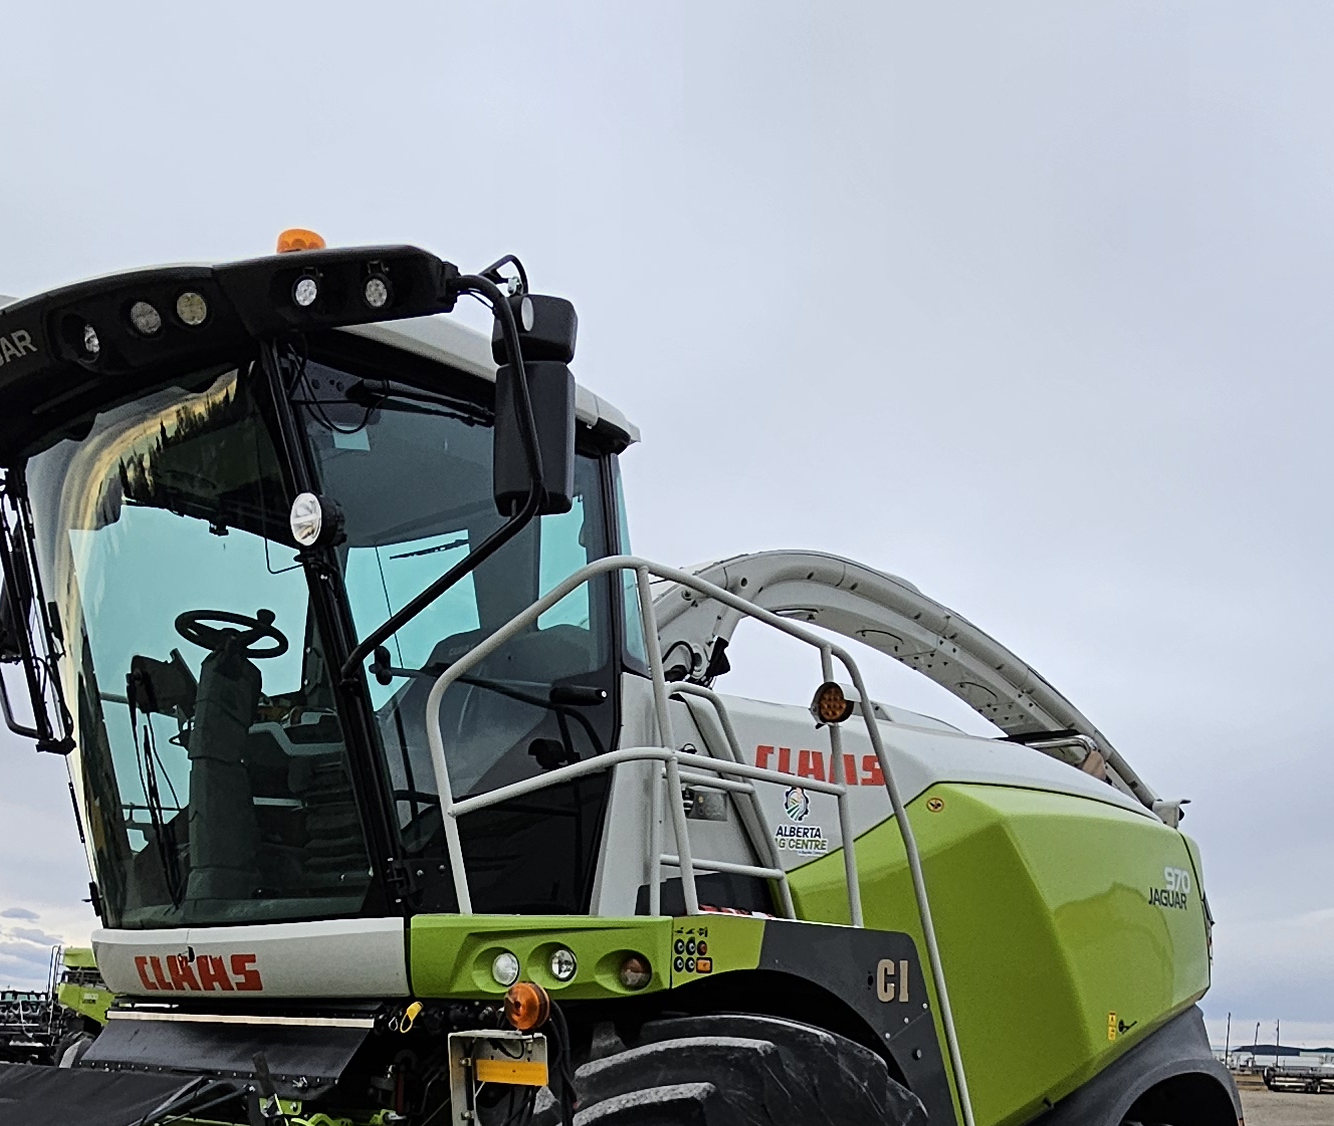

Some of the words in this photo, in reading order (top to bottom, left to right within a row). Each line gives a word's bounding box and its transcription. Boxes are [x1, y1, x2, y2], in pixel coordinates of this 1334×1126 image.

[774, 837, 787, 849] G
[788, 838, 828, 851] CENTRE
[775, 825, 822, 840] ALBERTA
[1164, 866, 1192, 894] 970
[1148, 886, 1188, 911] JAGUAR
[133, 953, 264, 991] CLAAS
